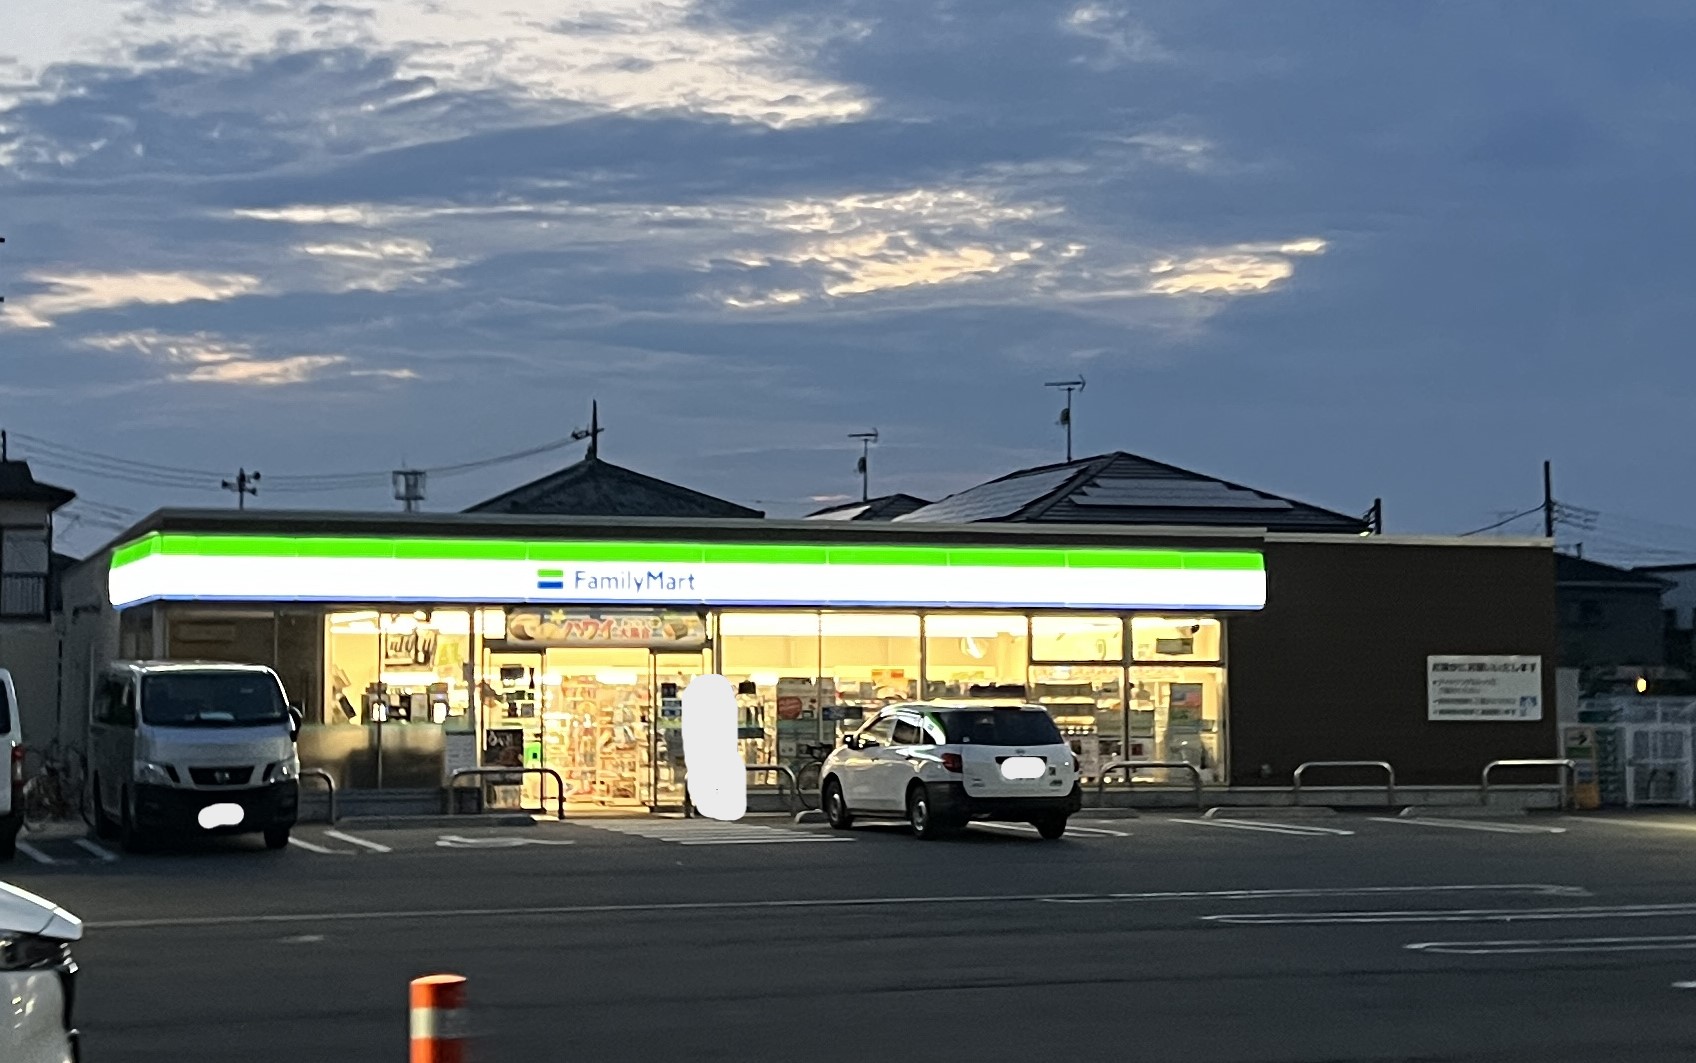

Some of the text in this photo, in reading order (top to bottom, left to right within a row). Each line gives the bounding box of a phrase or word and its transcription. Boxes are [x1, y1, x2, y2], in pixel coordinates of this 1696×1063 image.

[575, 570, 695, 592] FamilyMart
[564, 618, 616, 640] ハワイ
